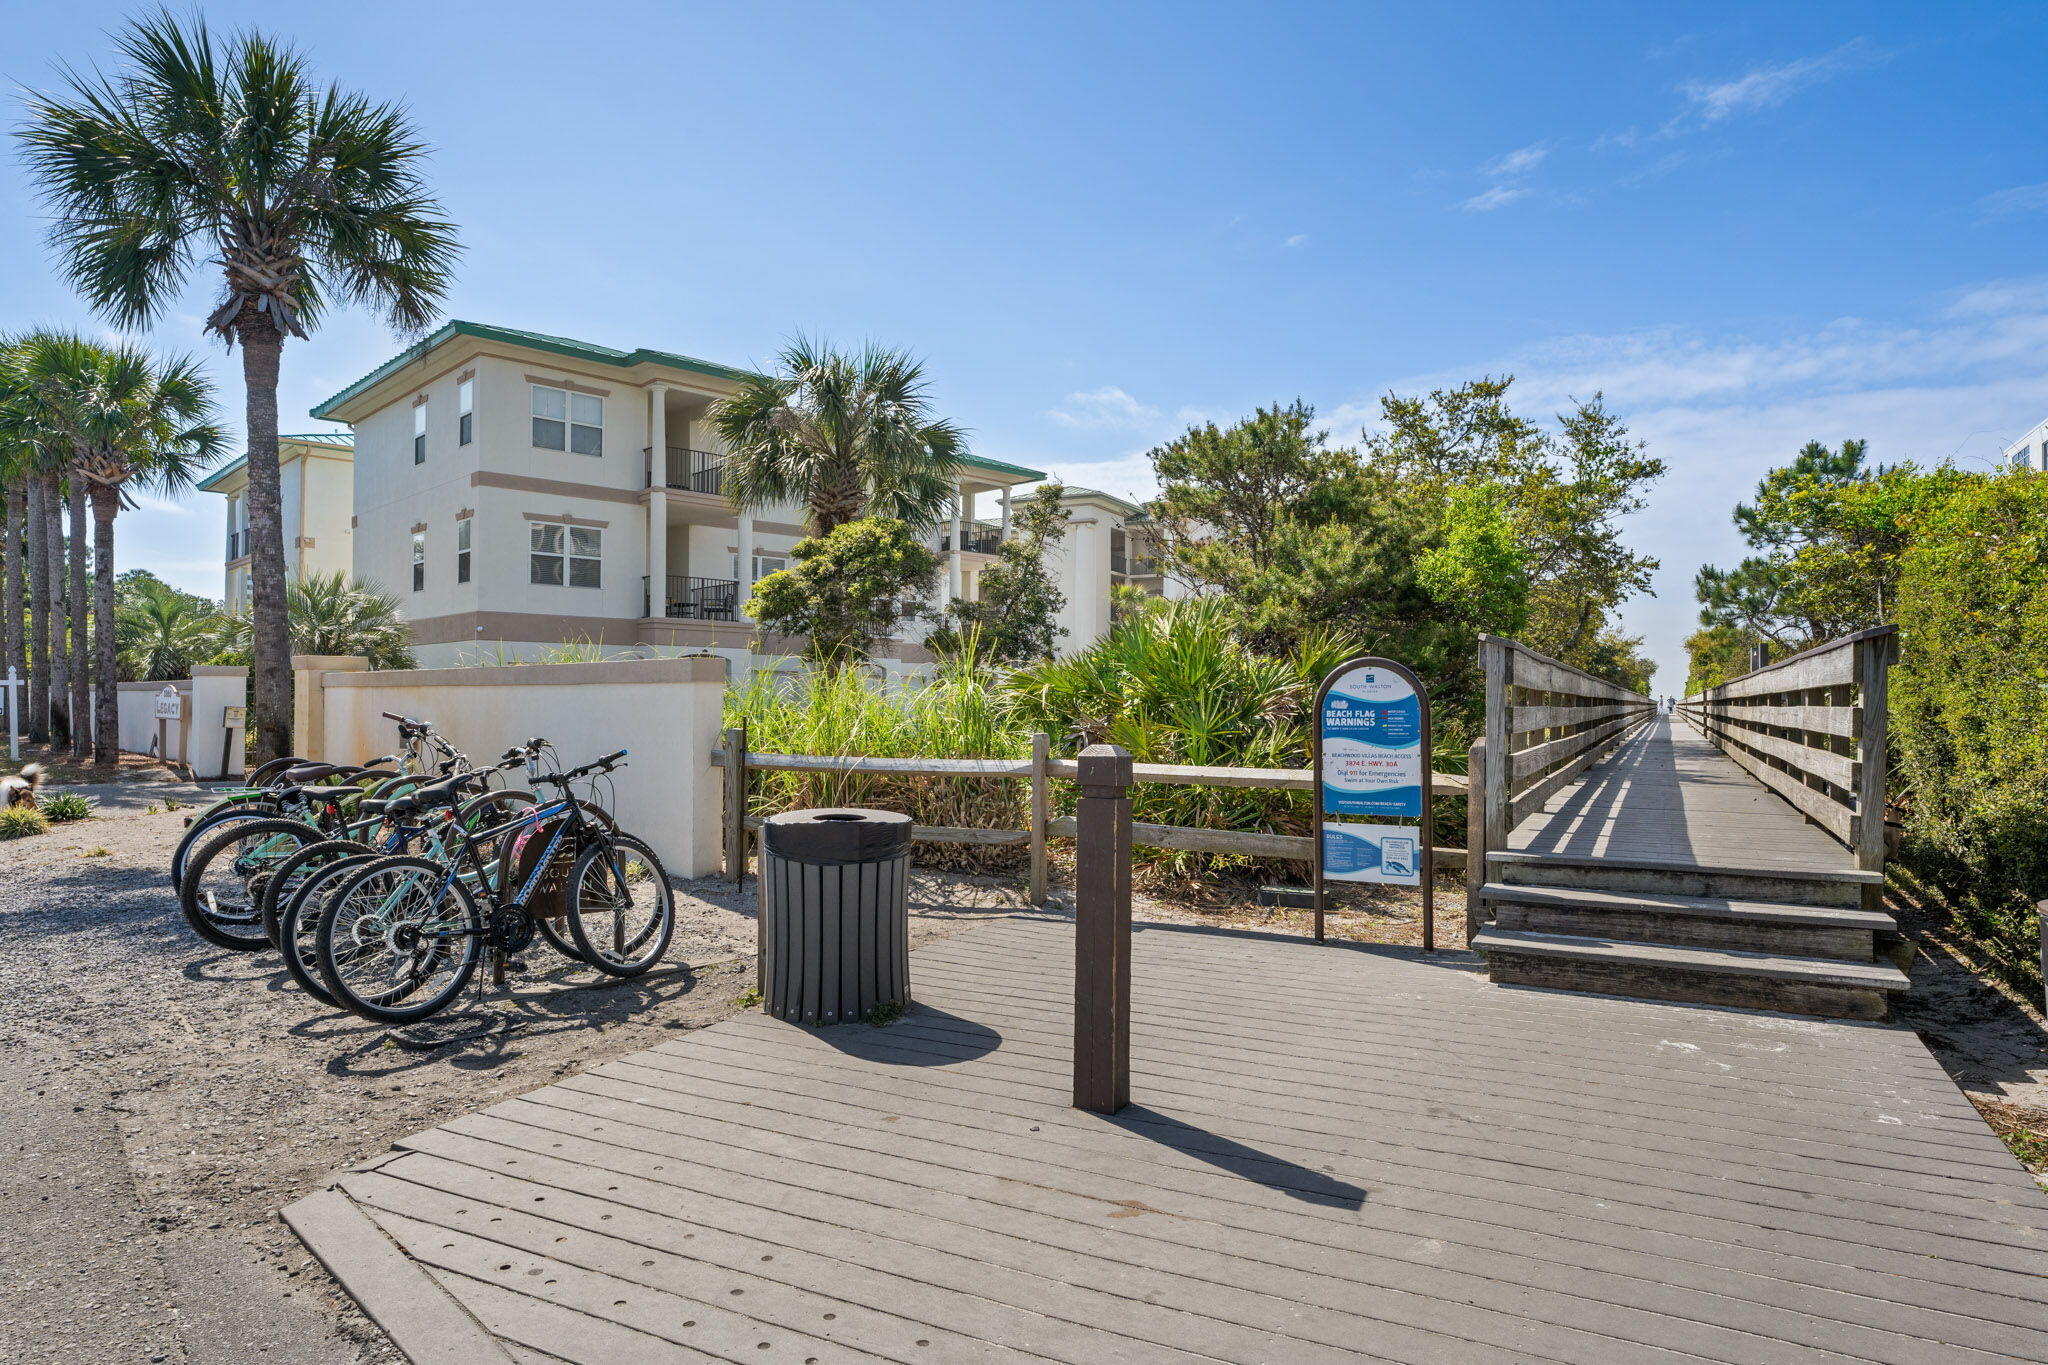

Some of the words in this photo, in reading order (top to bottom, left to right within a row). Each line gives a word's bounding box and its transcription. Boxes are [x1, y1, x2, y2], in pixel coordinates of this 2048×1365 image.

[157, 700, 179, 714] LEGACY
[1355, 710, 1375, 718] FLAG
[1326, 718, 1375, 726] WARNINGS
[518, 834, 563, 906] ROADMASTER
